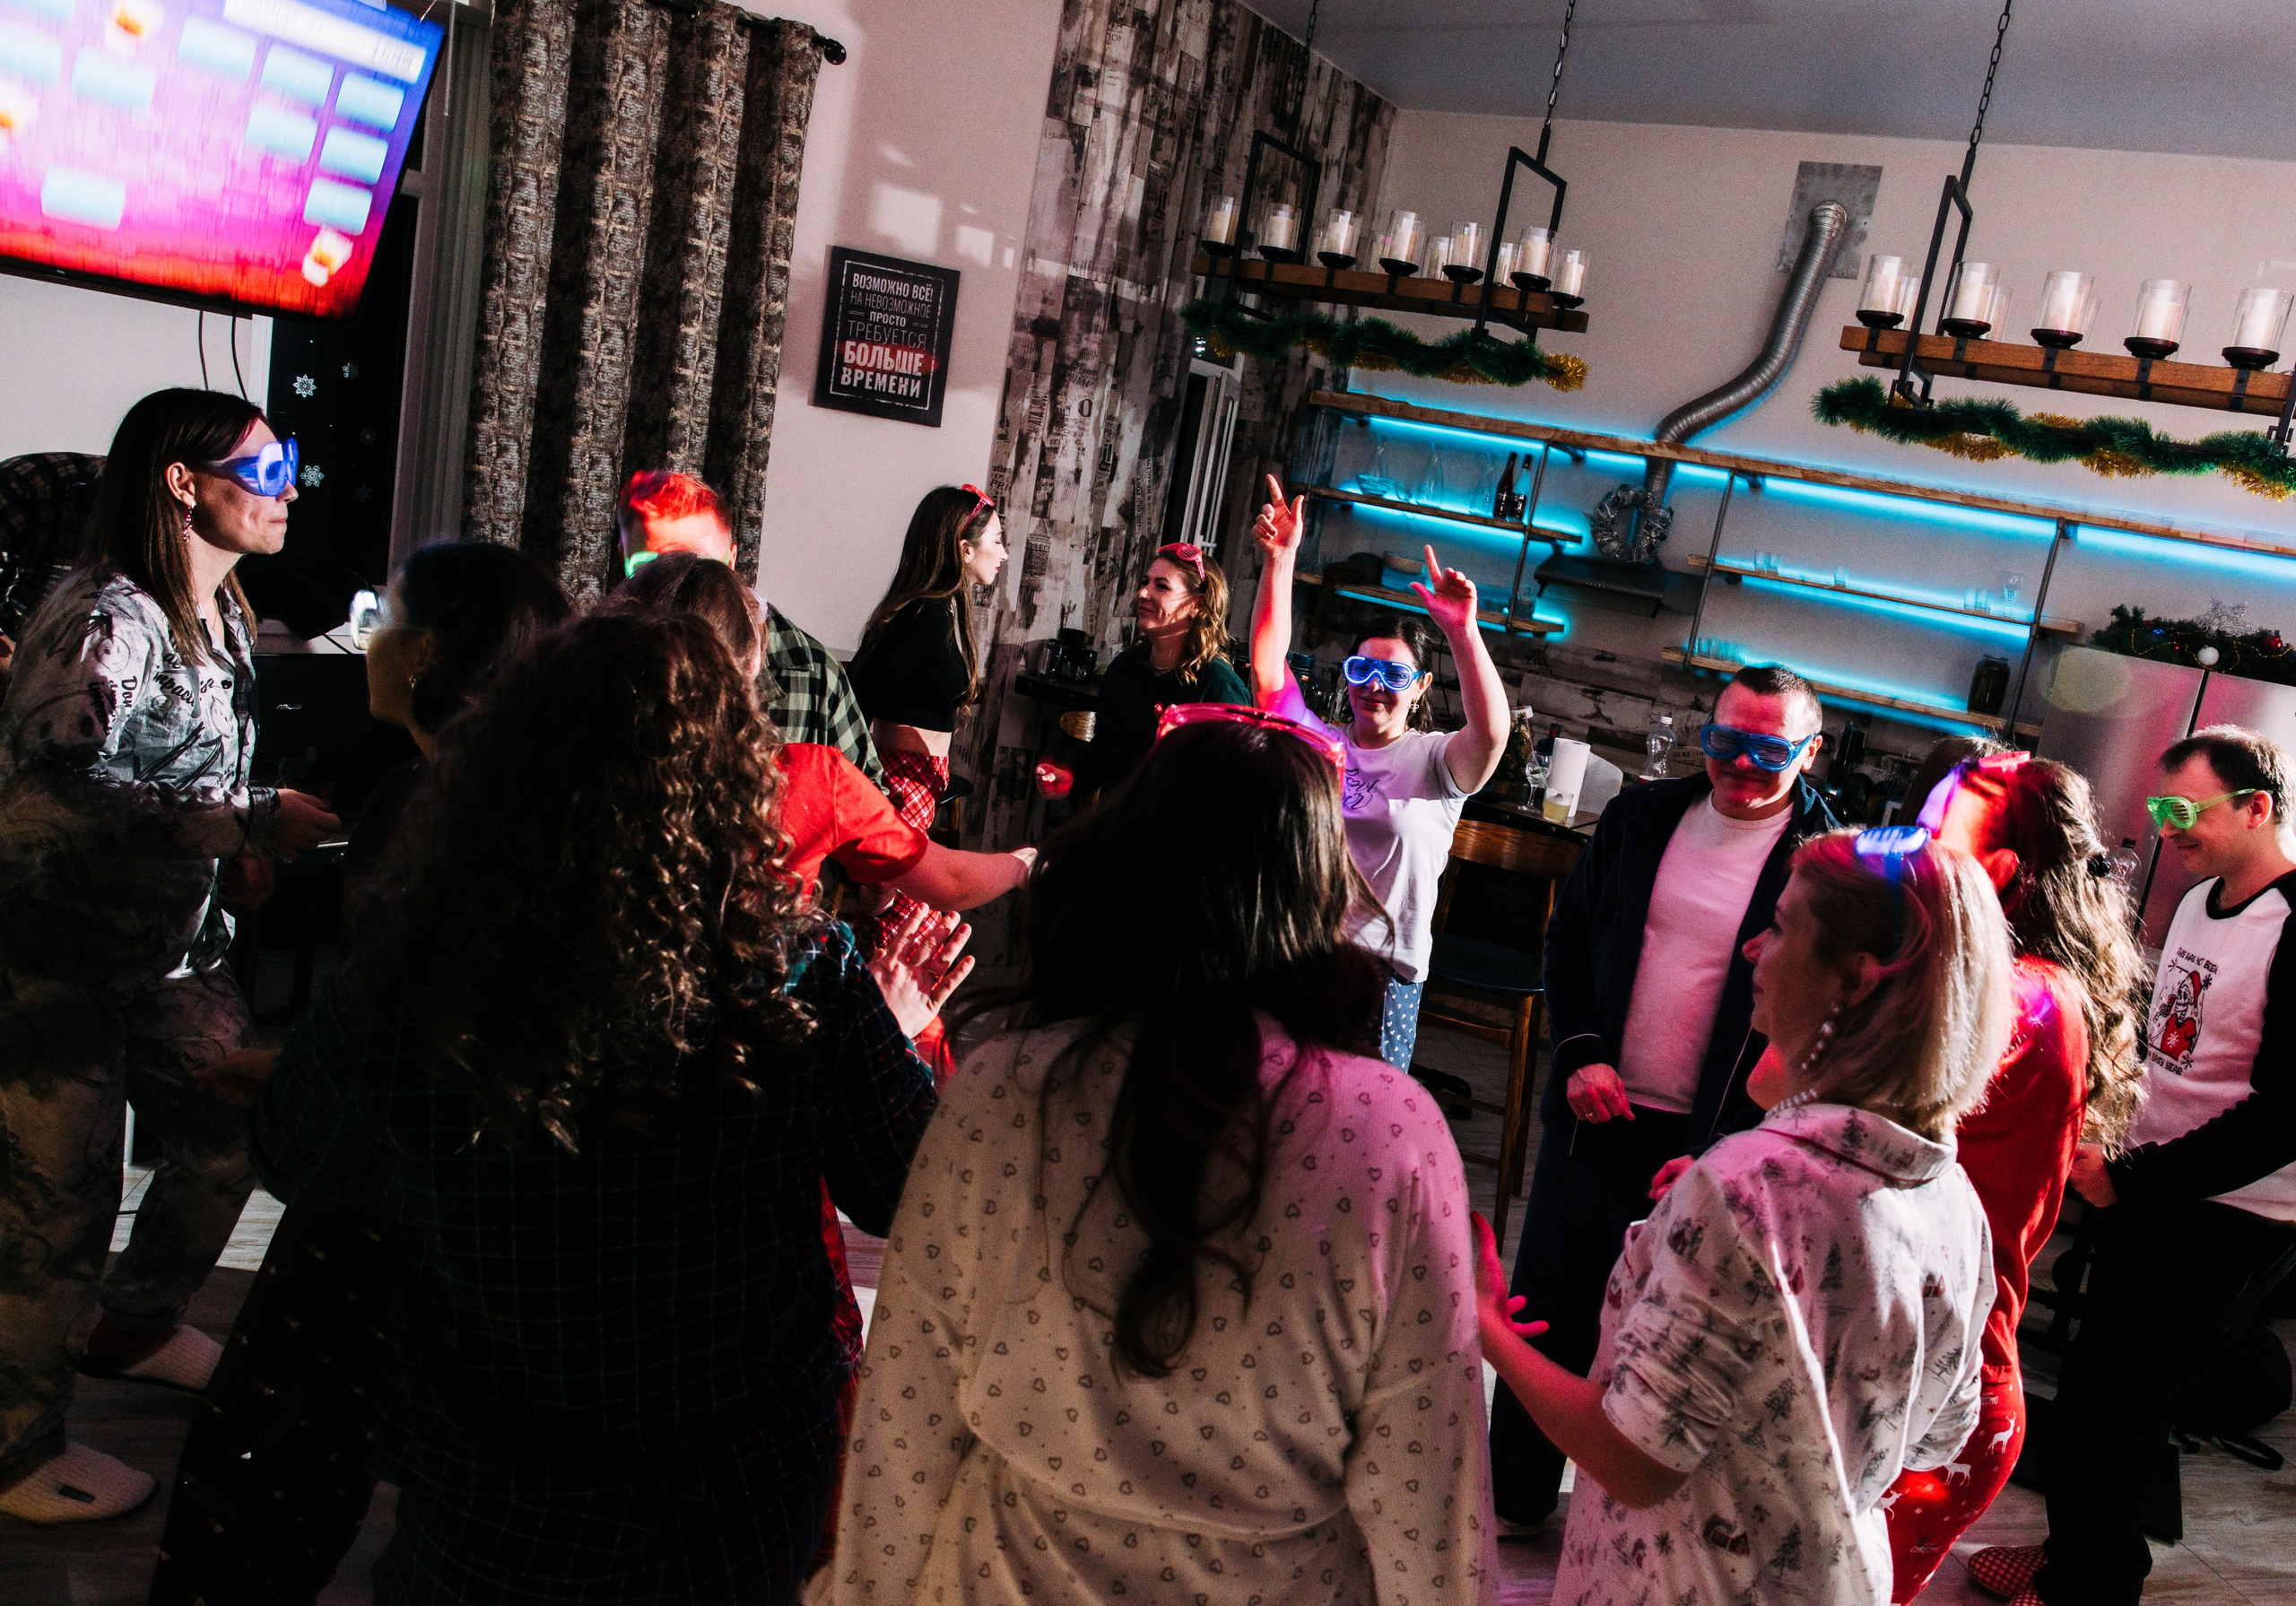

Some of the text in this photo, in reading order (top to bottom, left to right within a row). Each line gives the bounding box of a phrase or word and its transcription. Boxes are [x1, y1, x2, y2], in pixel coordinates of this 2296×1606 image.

[852, 273, 934, 302] ВОЗМОЖНО ВСЁ!
[850, 291, 932, 319] НА НЕВОЗМОЖНОЕ
[869, 311, 907, 327] ПРОСТО
[848, 319, 927, 351] ТРЕБУЕТСЯ
[843, 340, 925, 377] БОЛЬШЕ
[840, 367, 921, 398] ВРЕМЕНИ
[2164, 1061, 2182, 1076] YEAR
